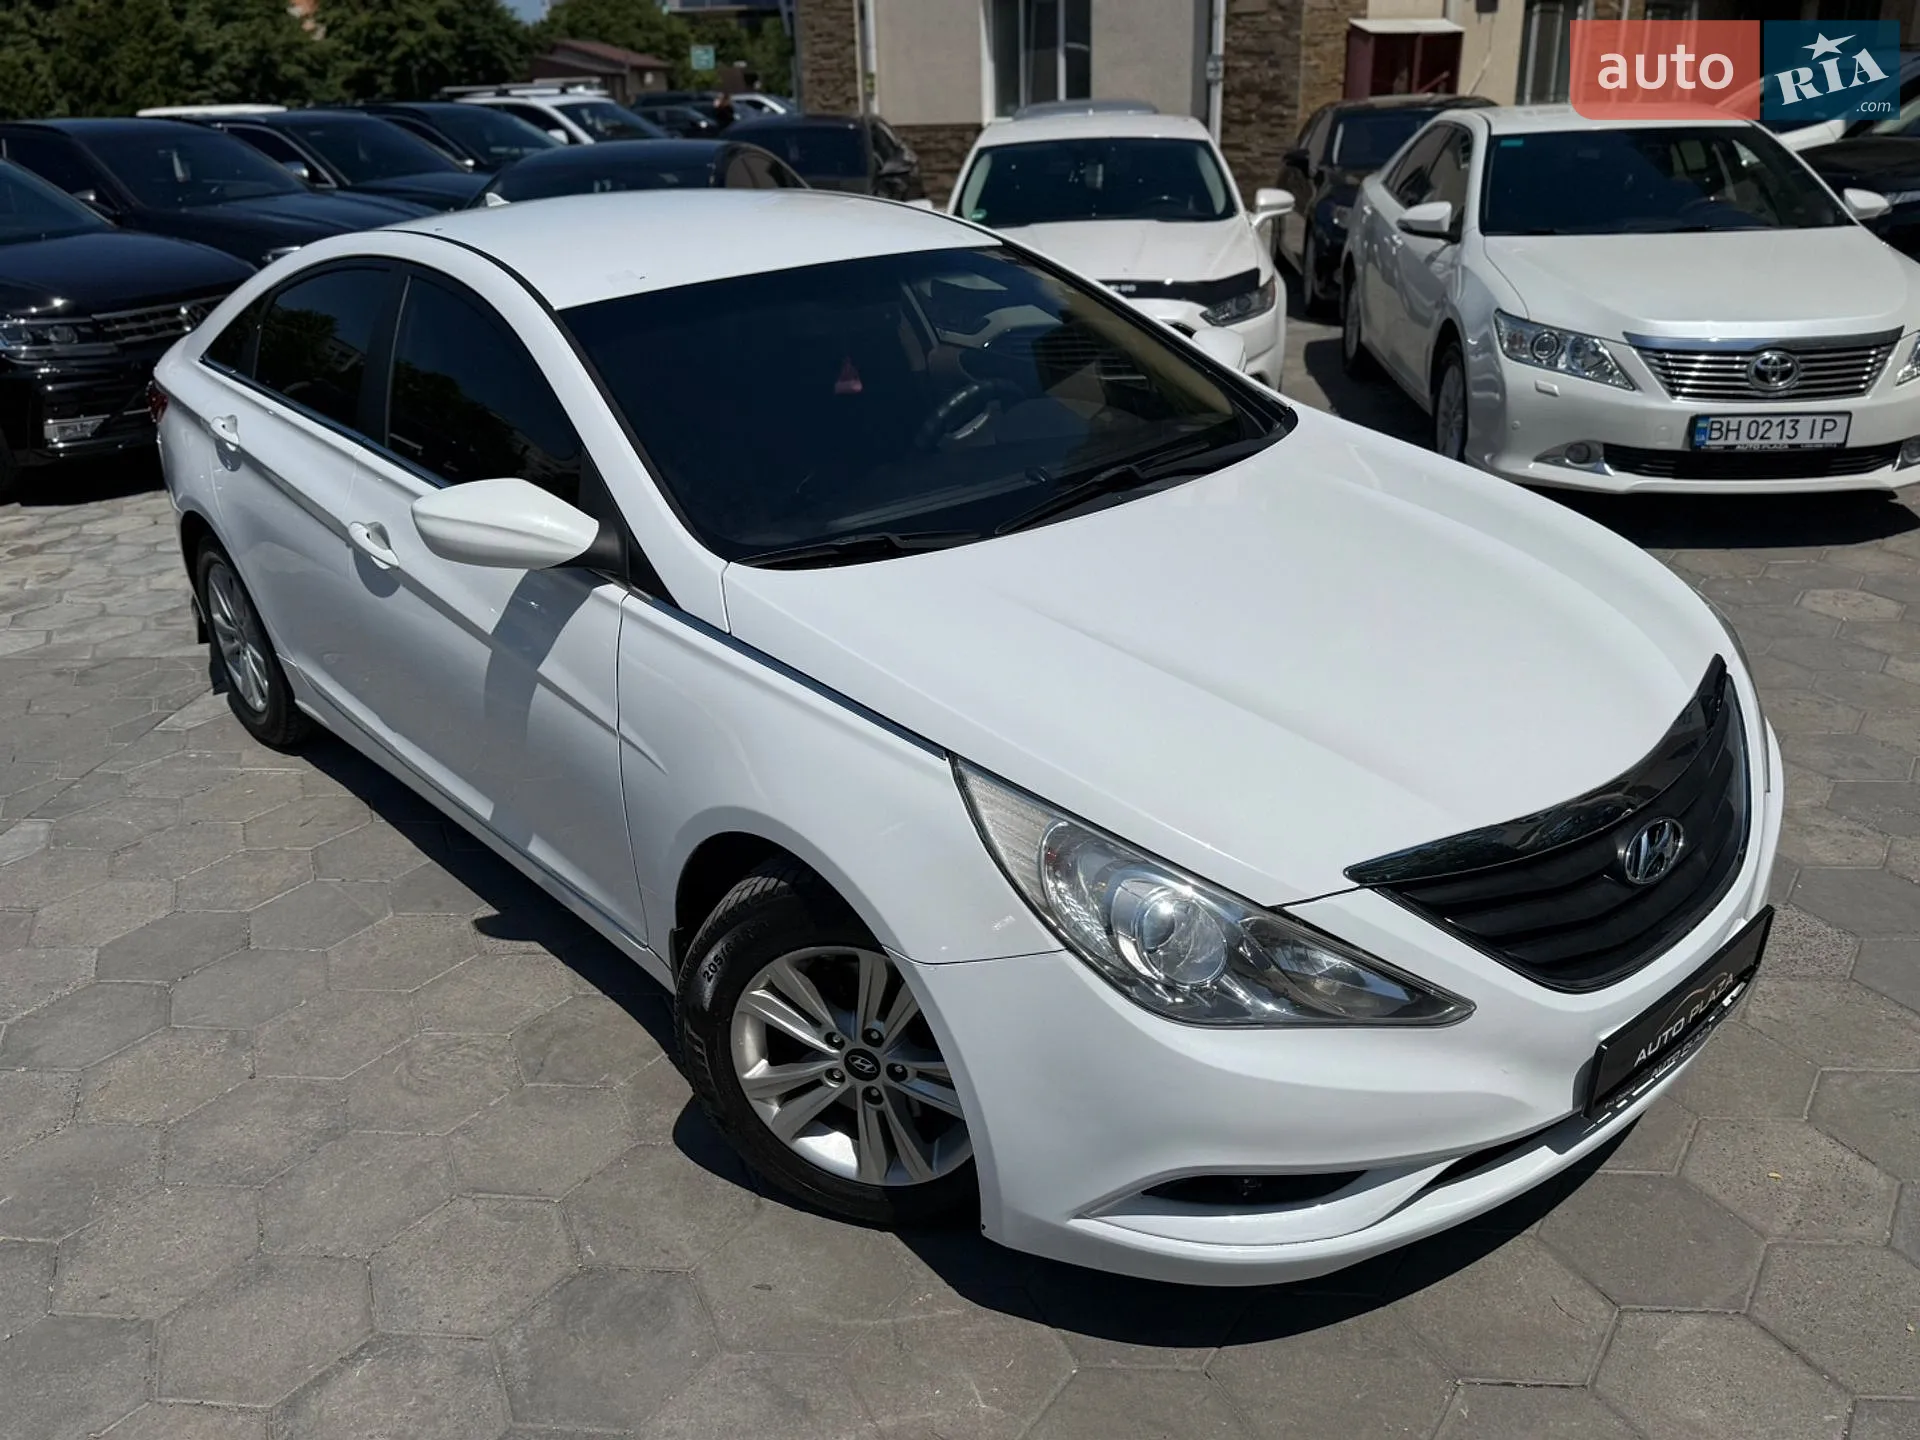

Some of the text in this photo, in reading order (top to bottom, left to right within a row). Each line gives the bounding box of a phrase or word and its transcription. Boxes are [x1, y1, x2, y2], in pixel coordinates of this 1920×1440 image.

[1708, 418, 1838, 441] BH 0213 IP
[1633, 1016, 1685, 1068] AUTO
[1688, 972, 1734, 1023] PLAZA
